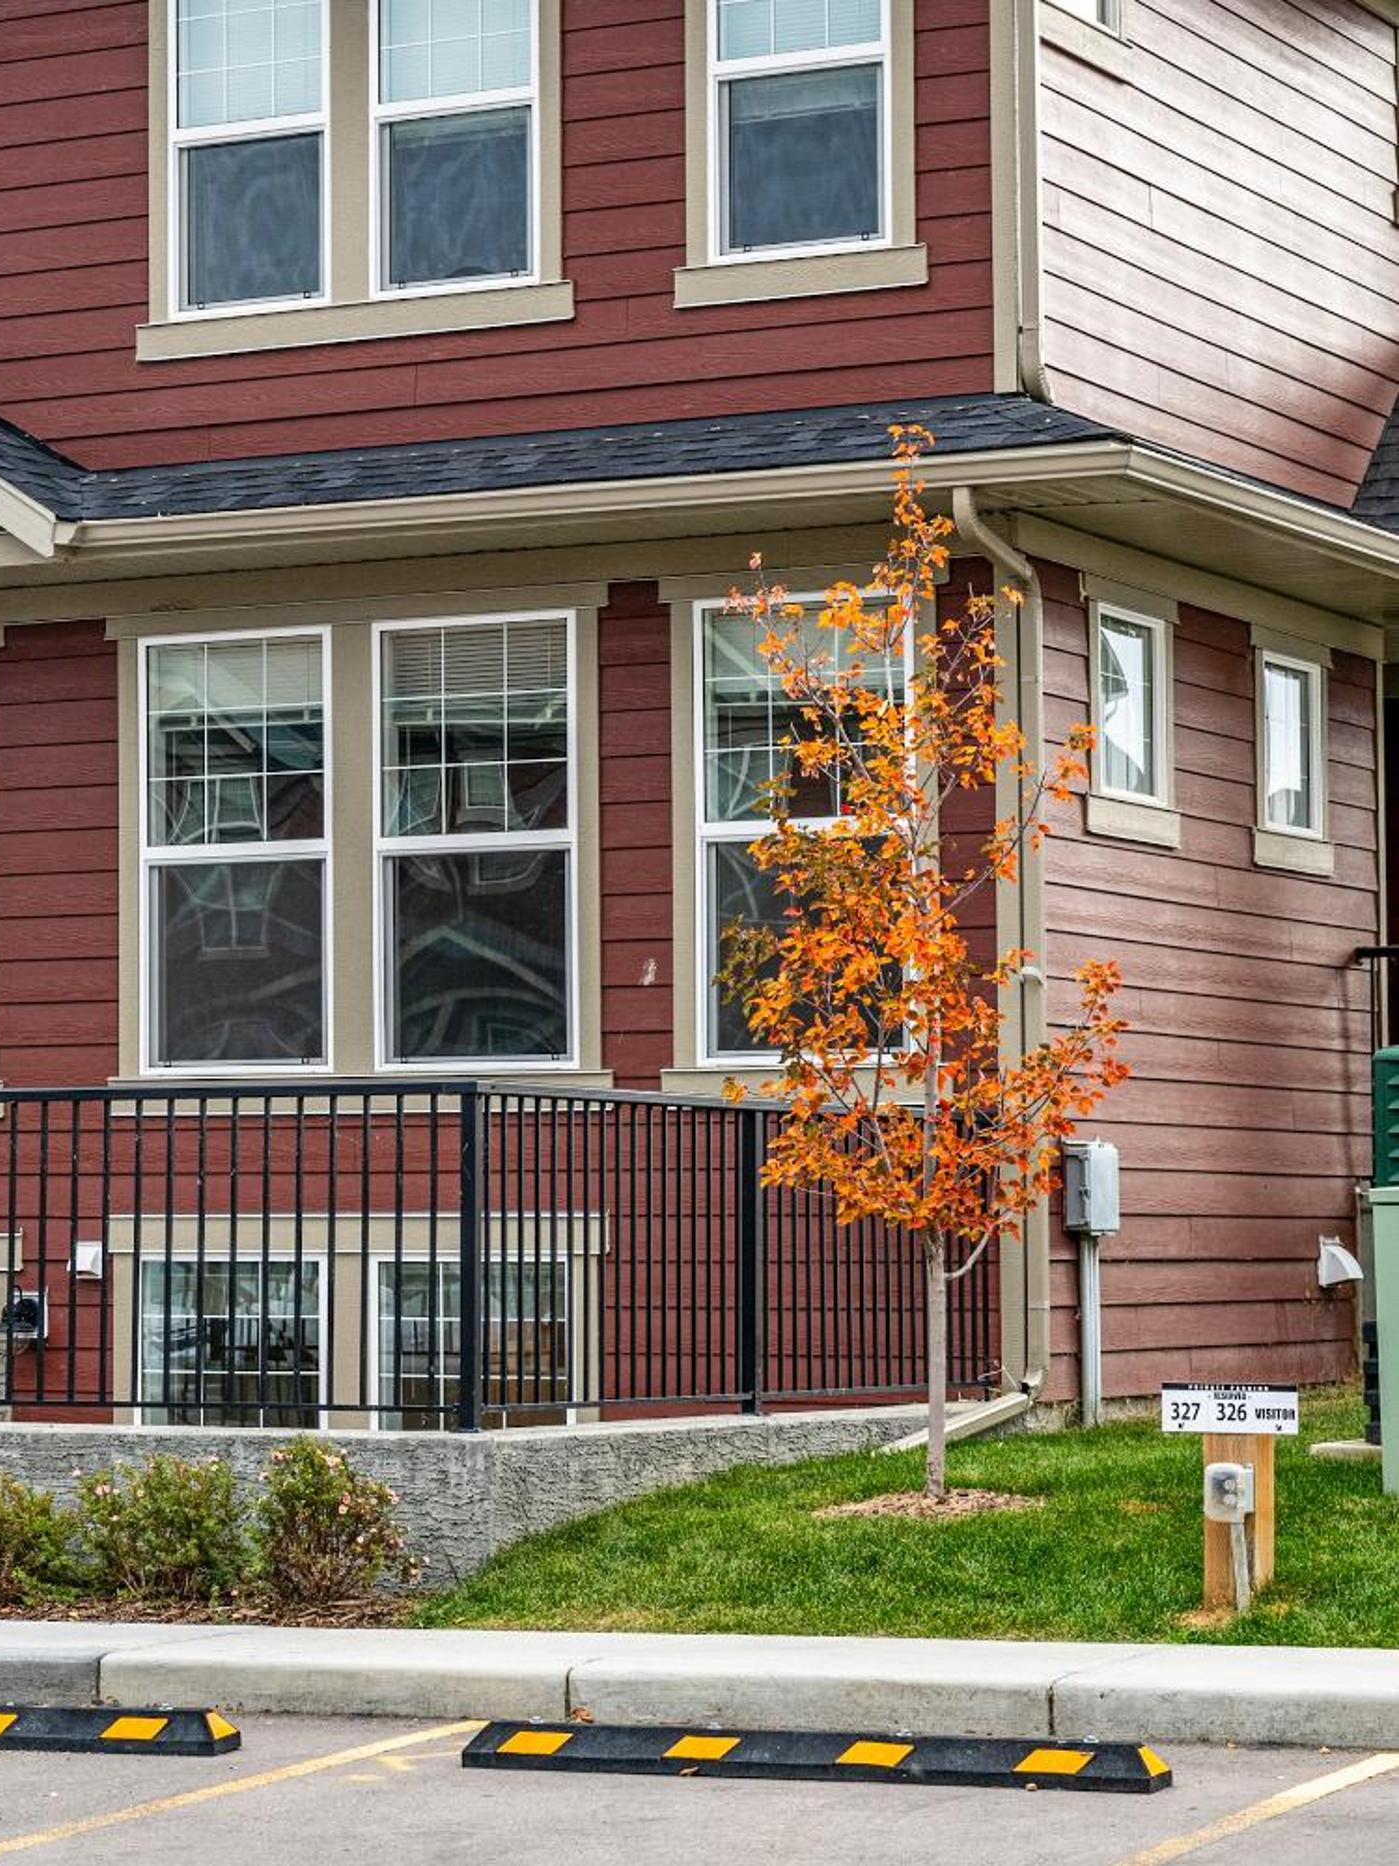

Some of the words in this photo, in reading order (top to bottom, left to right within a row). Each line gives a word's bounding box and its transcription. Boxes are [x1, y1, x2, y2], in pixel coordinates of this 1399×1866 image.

[1170, 1402, 1200, 1420] 327
[1216, 1403, 1247, 1421] 326
[1254, 1408, 1296, 1420] VISITOR
